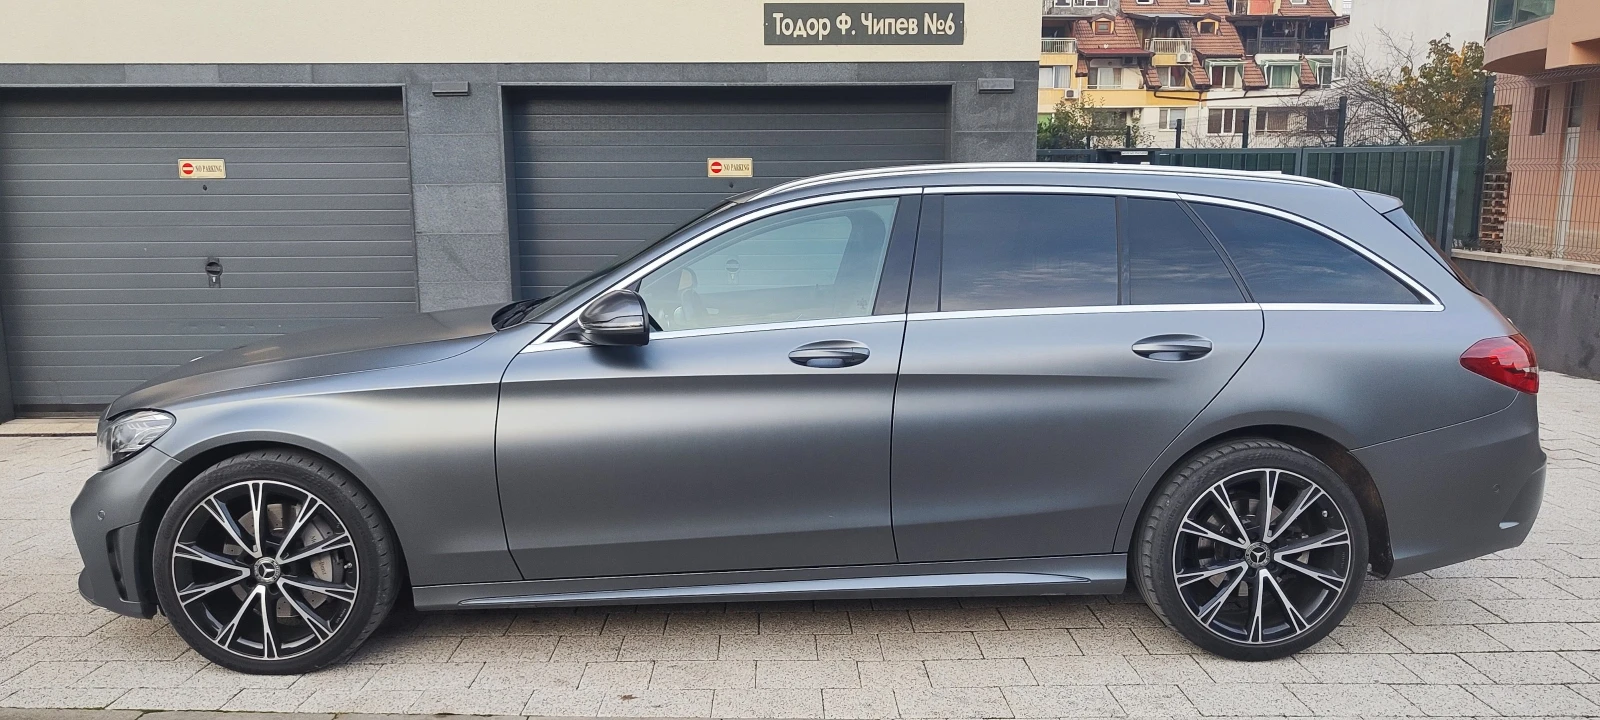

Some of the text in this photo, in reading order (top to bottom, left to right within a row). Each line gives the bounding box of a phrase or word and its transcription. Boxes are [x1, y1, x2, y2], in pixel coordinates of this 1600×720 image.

[772, 12, 956, 41] Тодор Ф. Чипев №6
